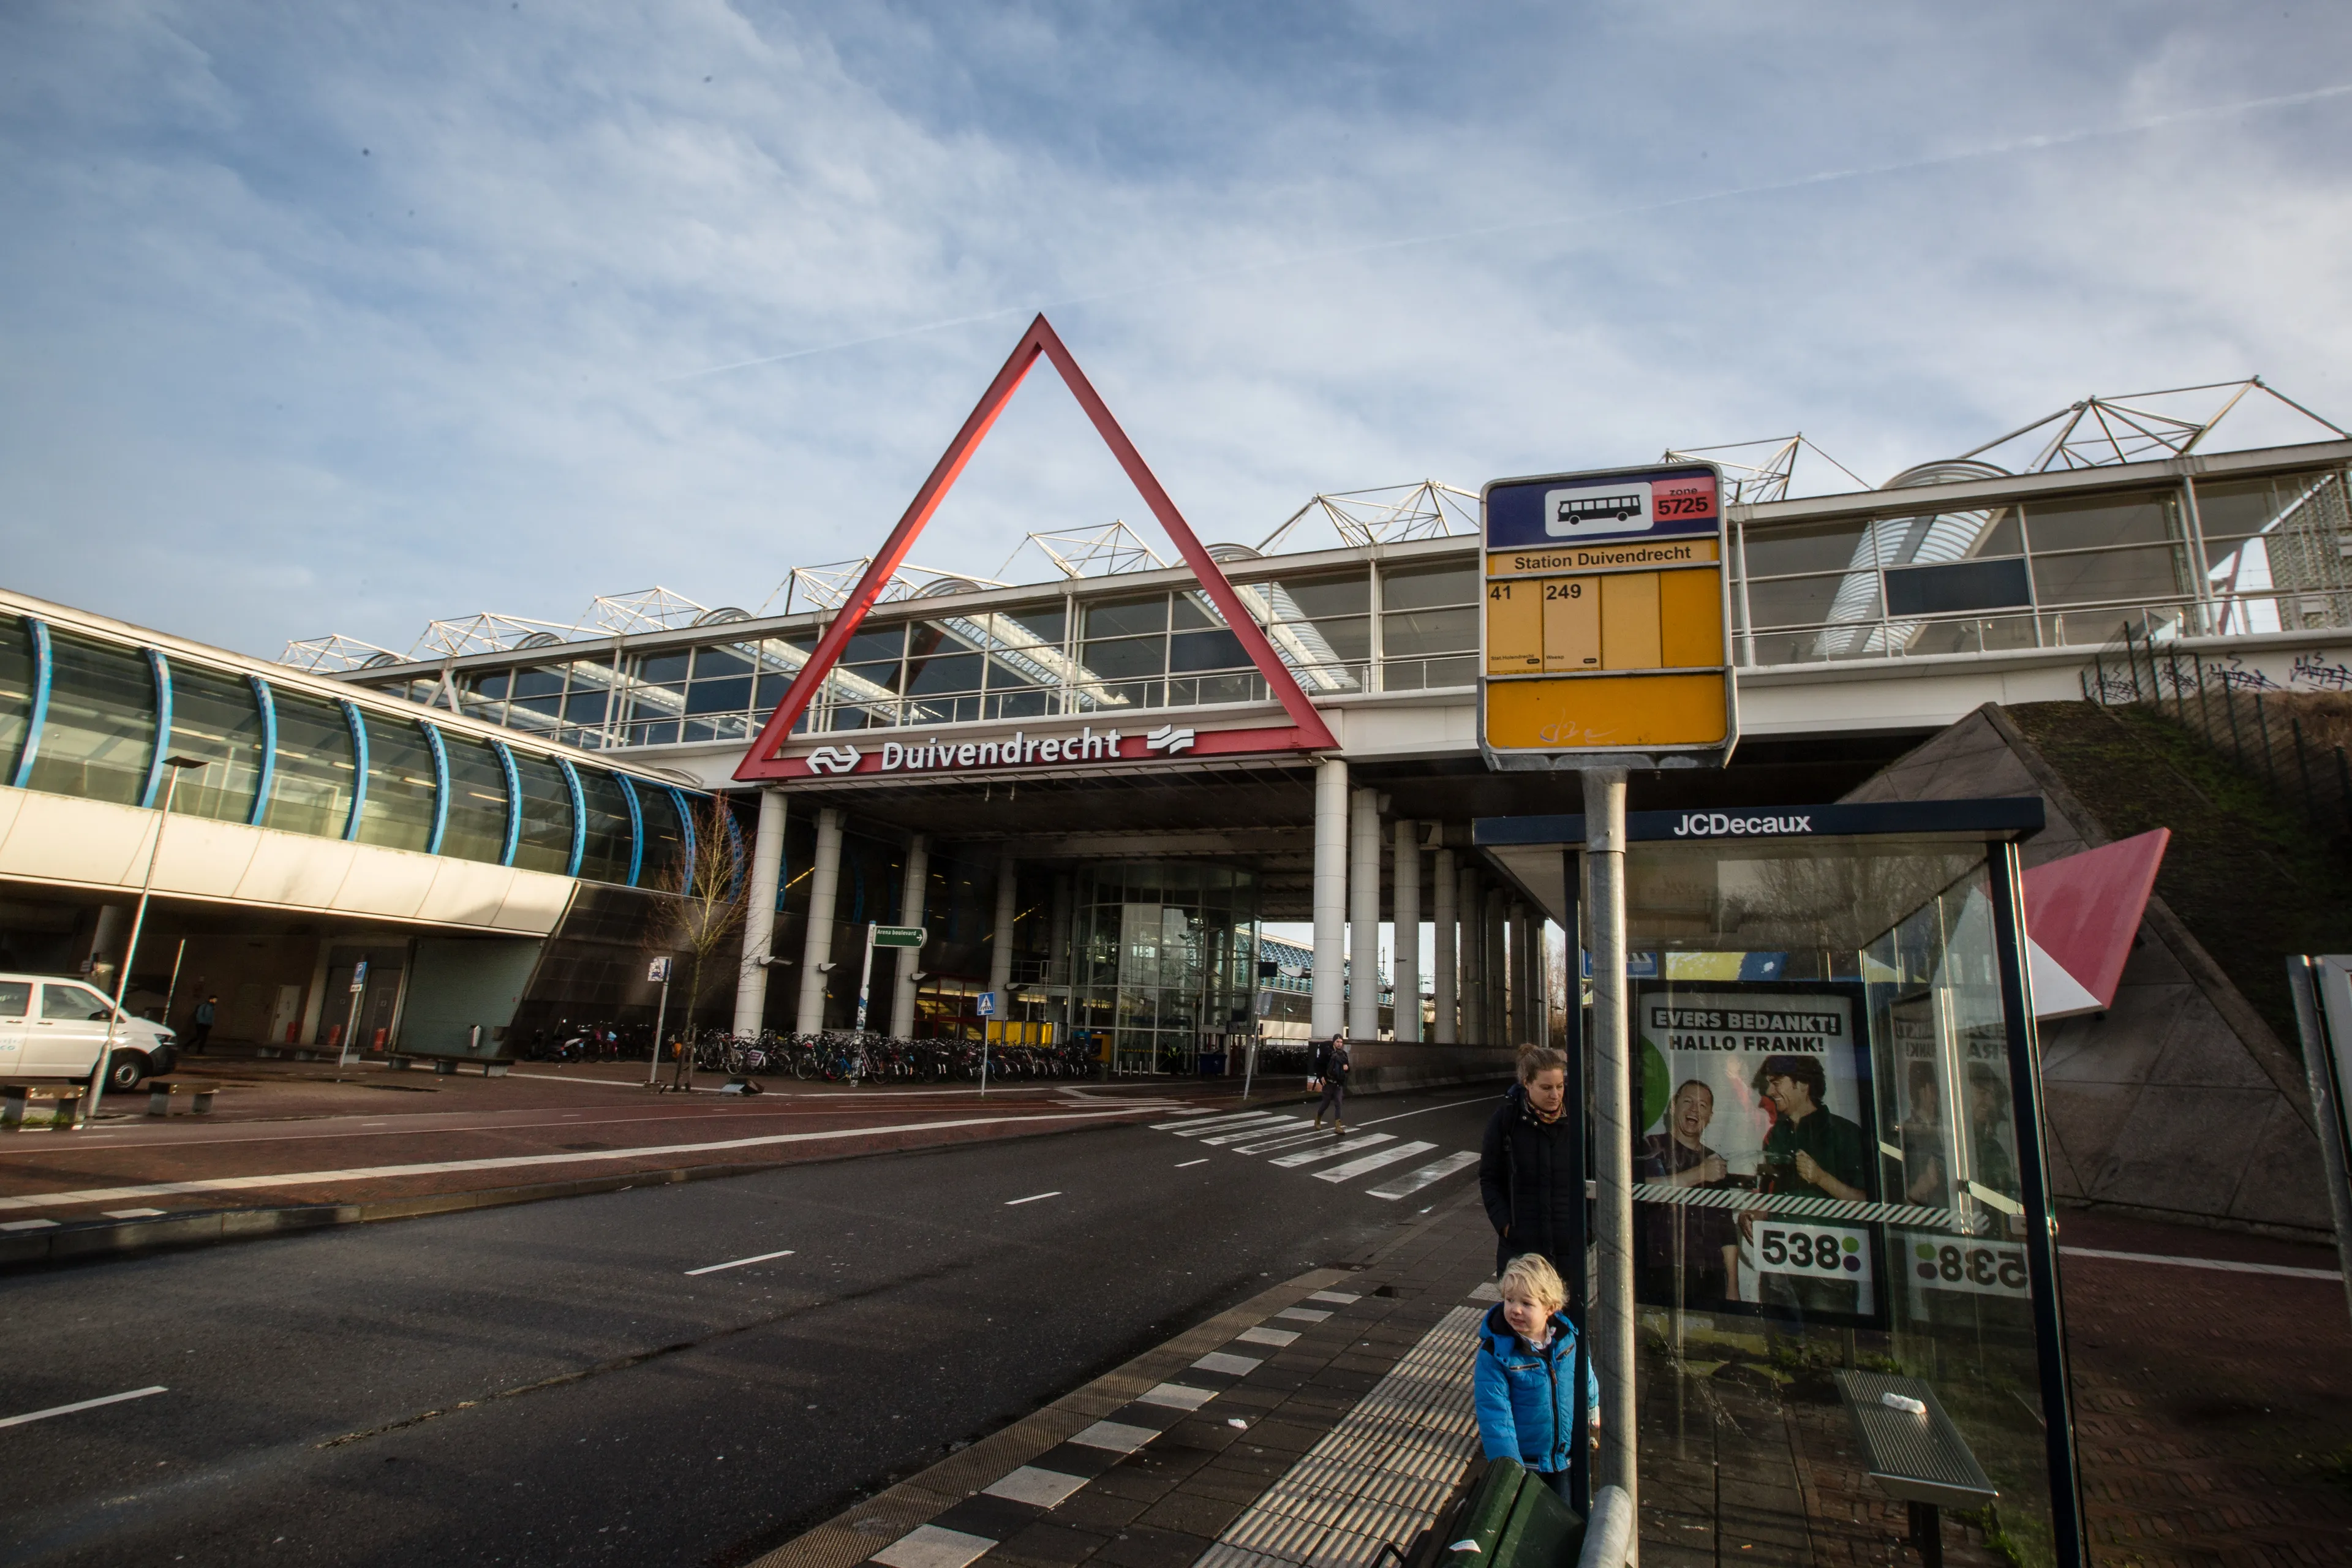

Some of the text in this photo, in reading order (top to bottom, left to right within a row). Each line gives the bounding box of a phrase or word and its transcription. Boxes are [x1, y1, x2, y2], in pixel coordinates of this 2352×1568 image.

[1658, 496, 1708, 515] 5725
[1514, 546, 1691, 570] Station Duivendrecht
[1490, 585, 1510, 600] 41
[1546, 584, 1581, 600] 249
[881, 726, 1121, 771] Duivendrecht
[1673, 813, 1812, 835] JCDecaux
[1656, 1011, 1836, 1033] EVERS BEDANKT!
[1669, 1035, 1824, 1052] HALLO FRANK!
[1762, 1229, 1841, 1270] 538
